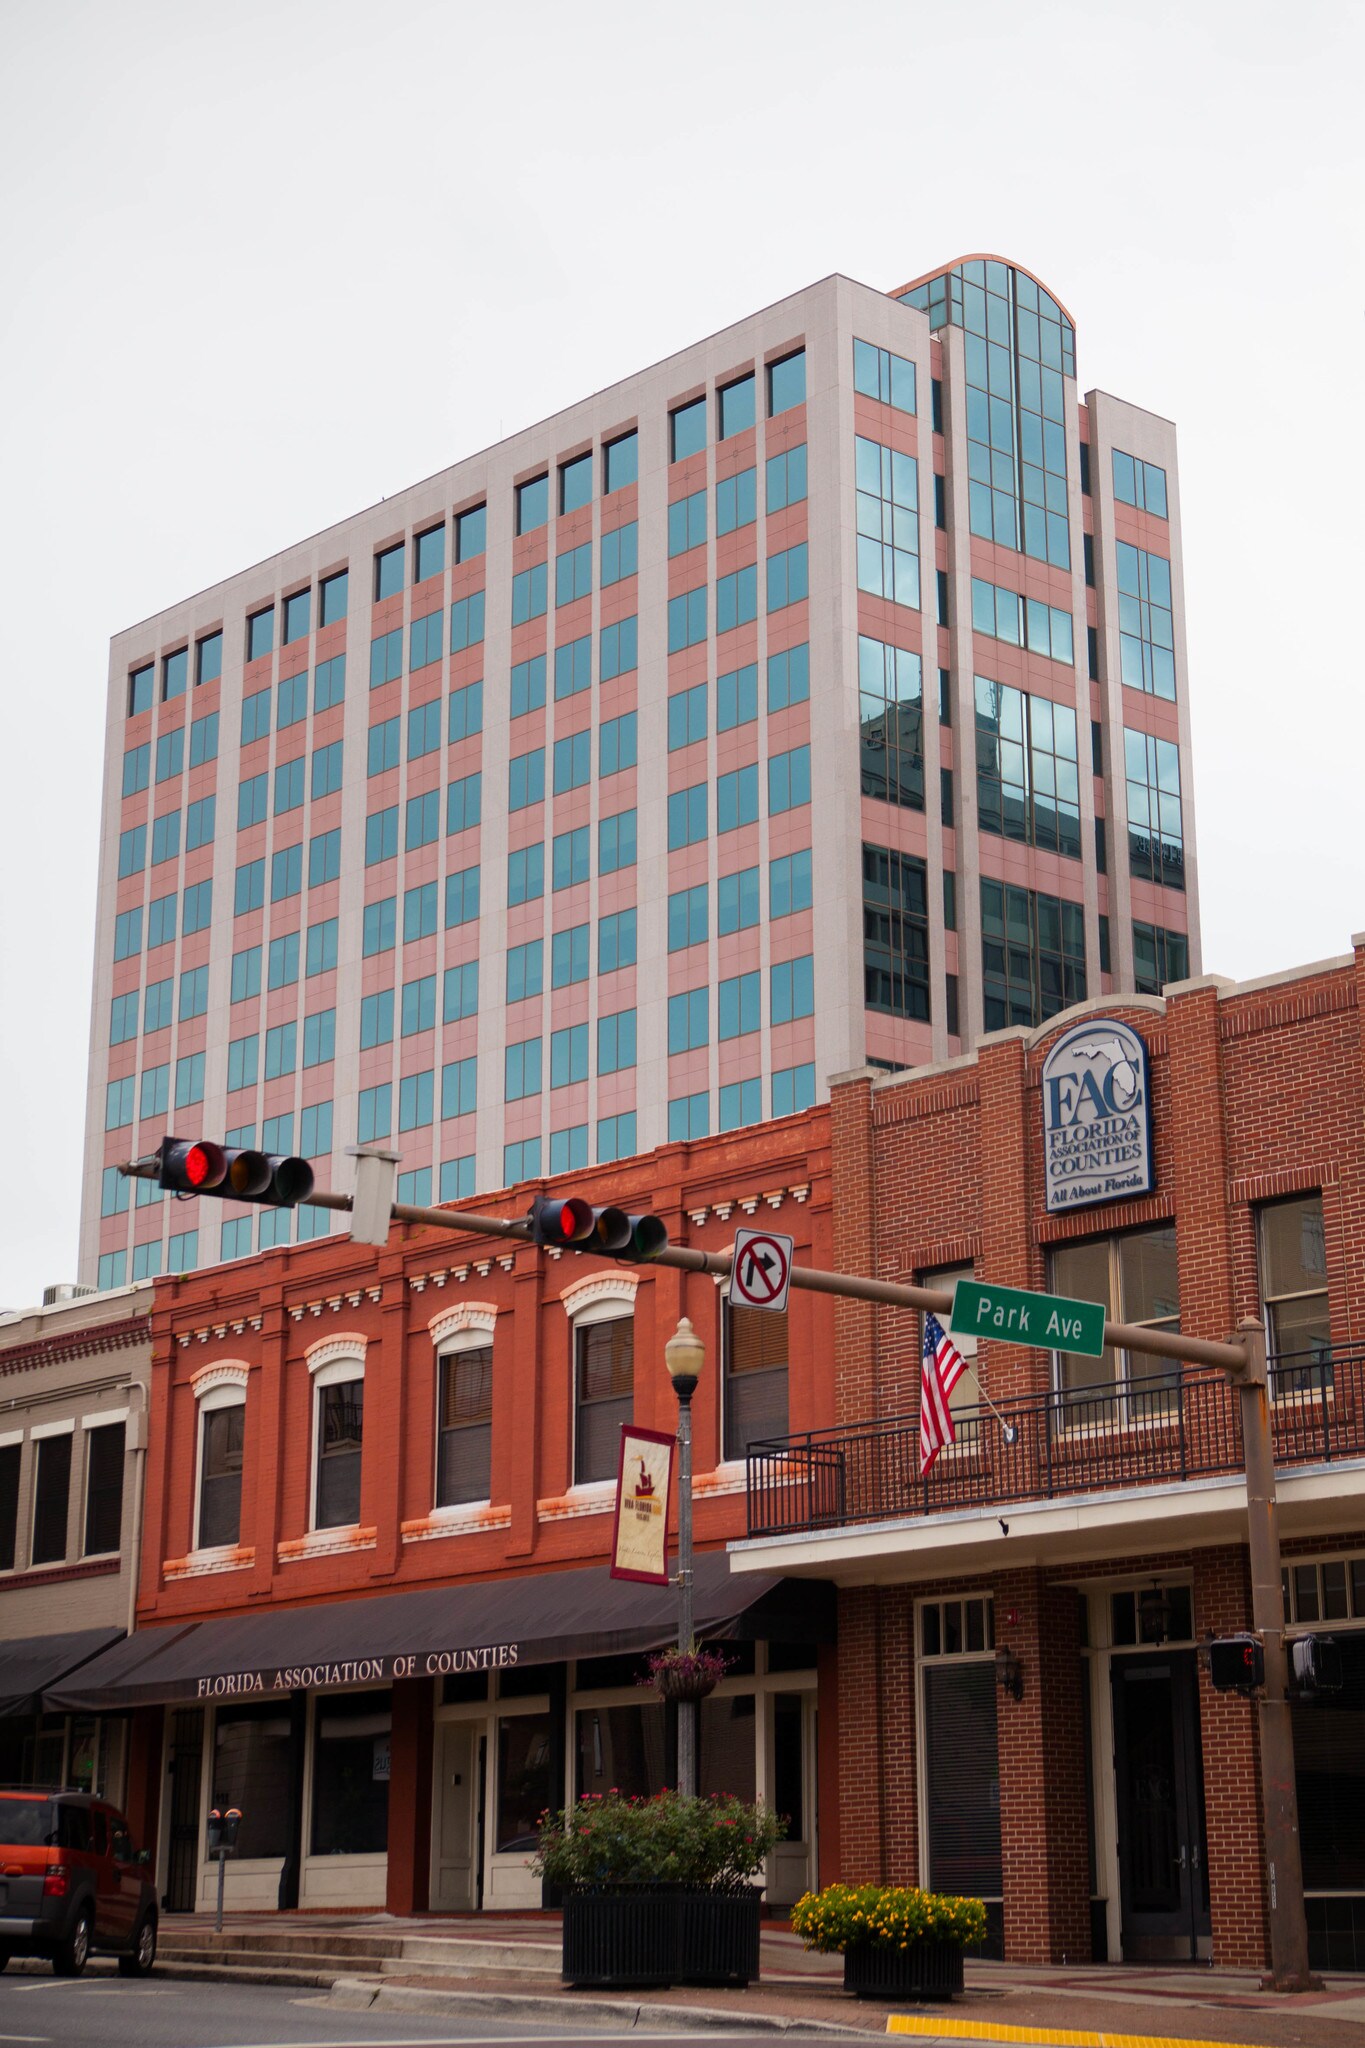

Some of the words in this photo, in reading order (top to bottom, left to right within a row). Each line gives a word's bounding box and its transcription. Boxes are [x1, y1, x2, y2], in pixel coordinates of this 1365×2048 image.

[1045, 1058, 1142, 1131] FAC
[1049, 1114, 1140, 1148] FLORIDA
[1049, 1133, 1123, 1159] ASSOCIATION
[1125, 1130, 1141, 1142] OF
[1050, 1143, 1142, 1177] COUNTIES
[1051, 1188, 1067, 1204] All
[1070, 1183, 1102, 1200] About
[1104, 1174, 1143, 1192] Florida
[977, 1297, 1031, 1331] Park
[1045, 1310, 1082, 1340] Ave
[635, 1500, 652, 1513] FLORIDA
[197, 1672, 264, 1697] FLORIDA
[273, 1658, 384, 1689] ASSOCIATION
[393, 1656, 417, 1677] OF
[426, 1644, 518, 1674] COUNTIES
